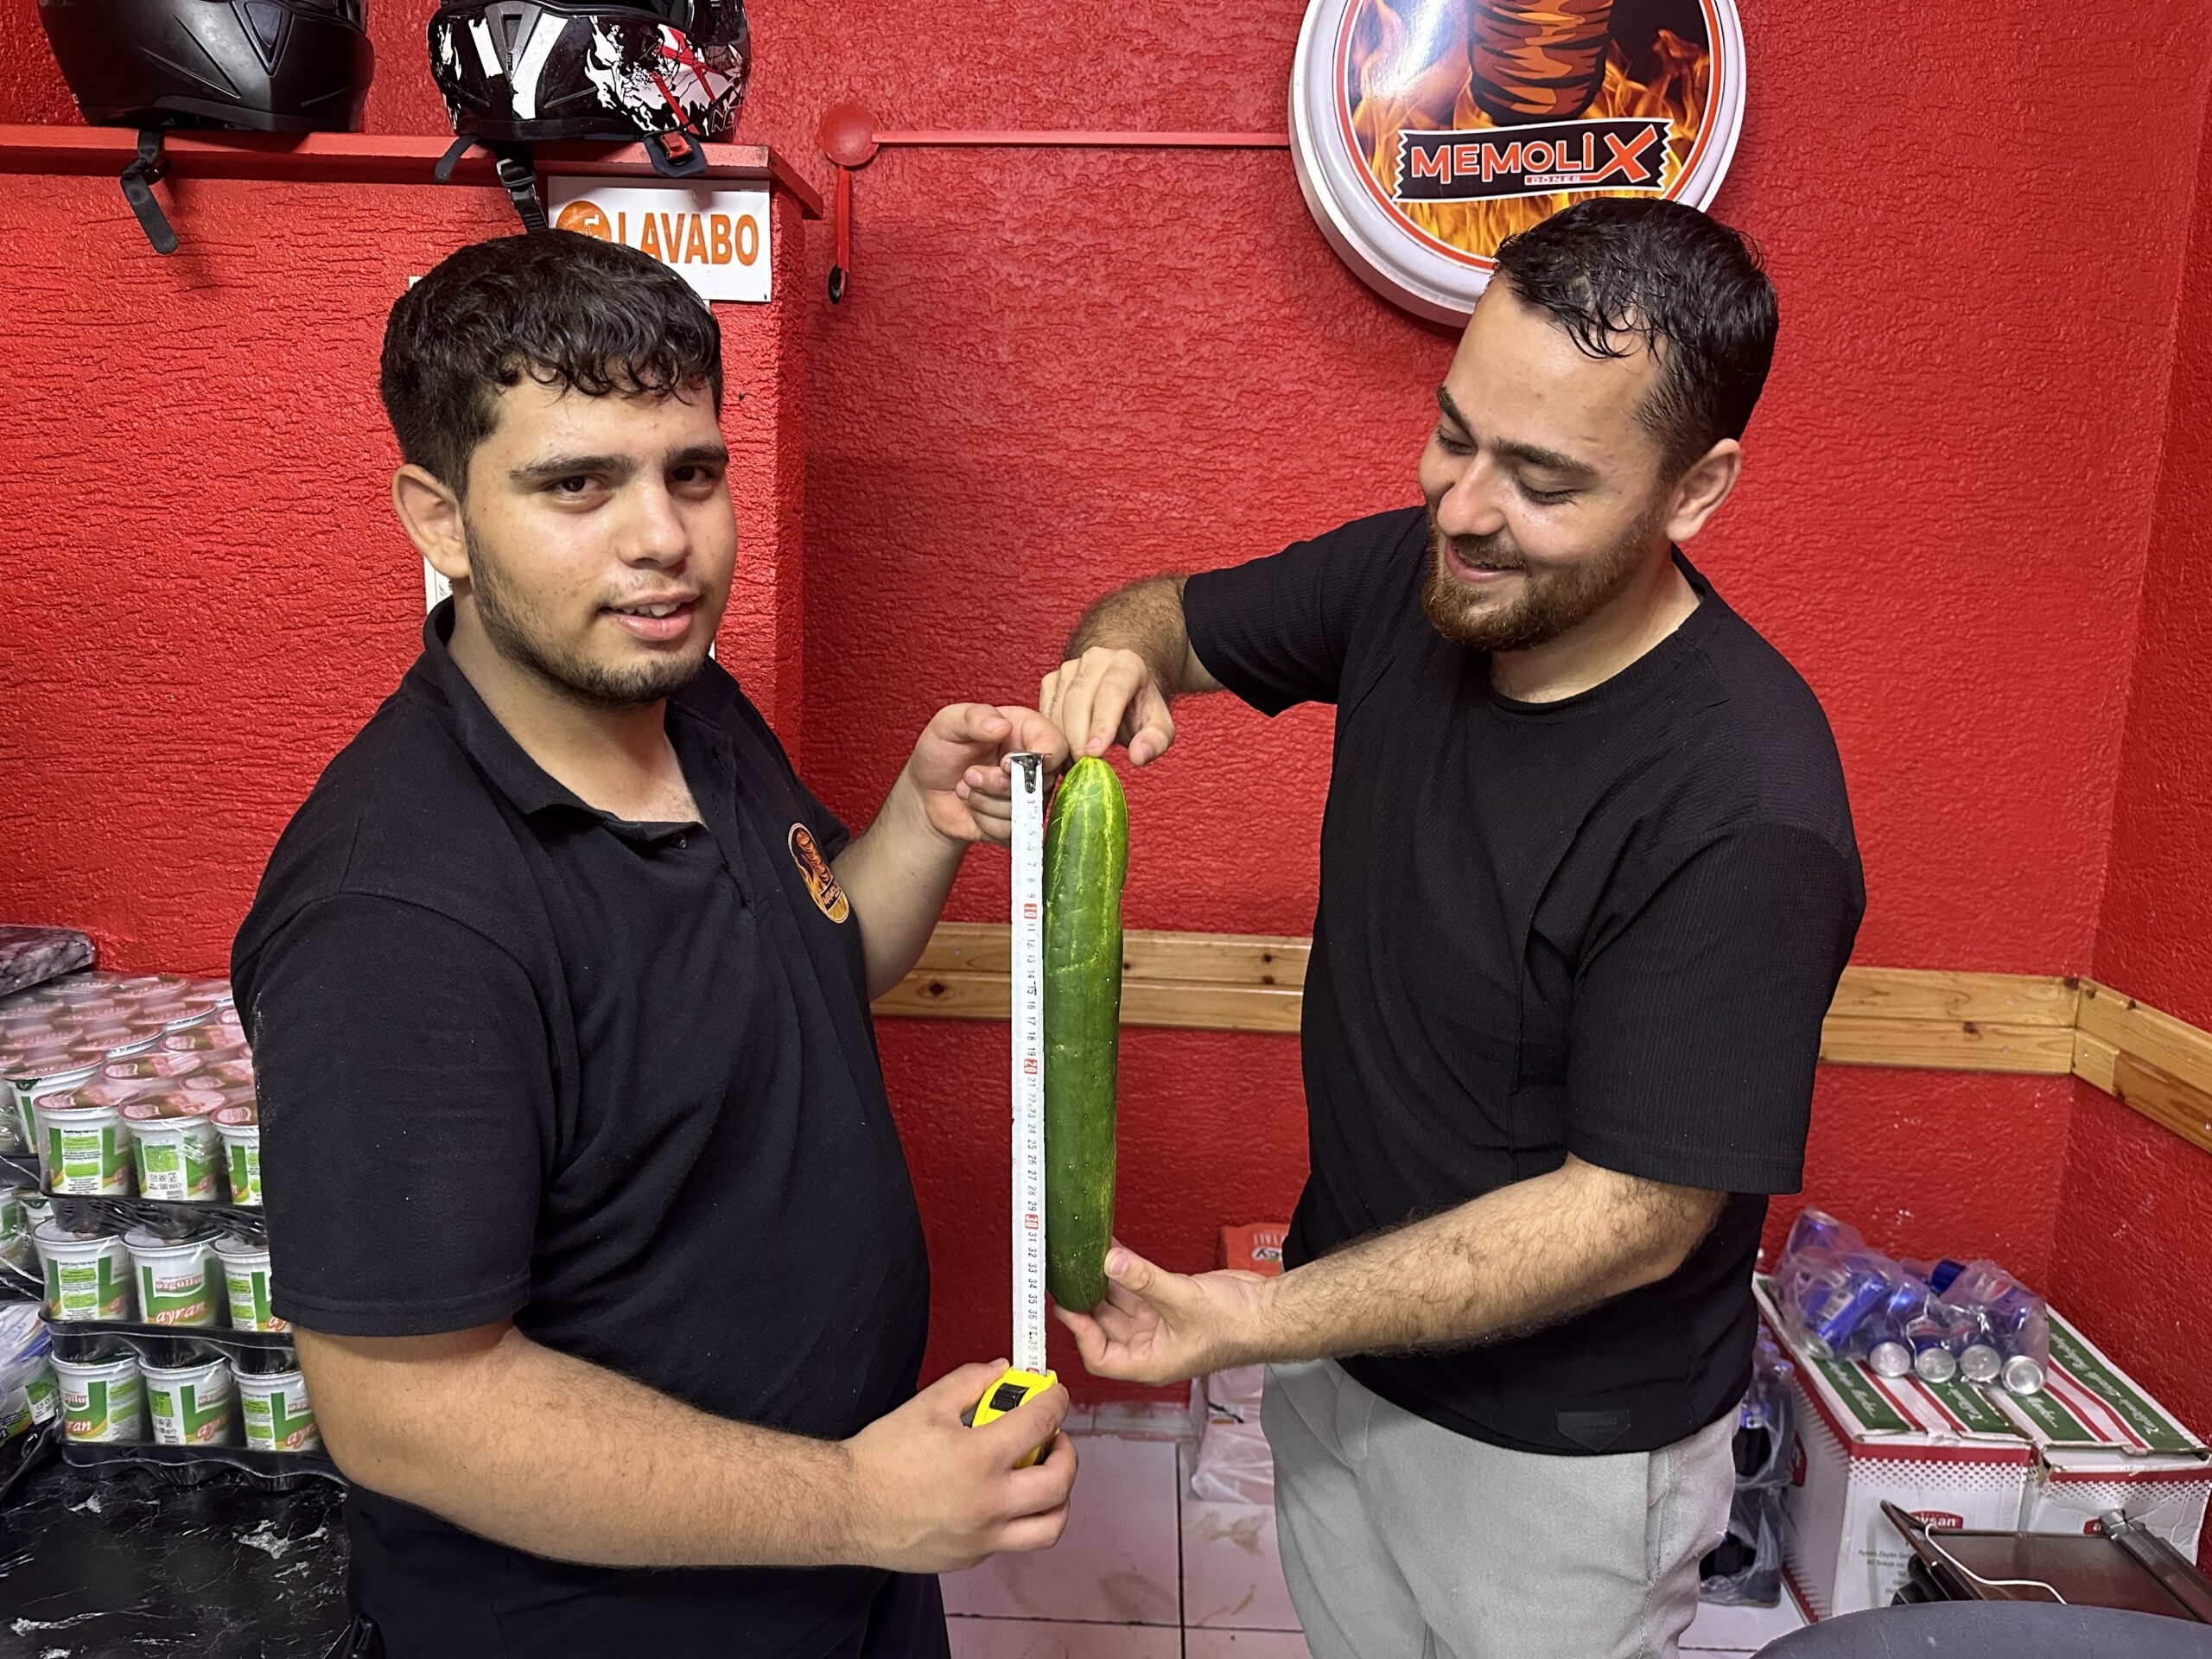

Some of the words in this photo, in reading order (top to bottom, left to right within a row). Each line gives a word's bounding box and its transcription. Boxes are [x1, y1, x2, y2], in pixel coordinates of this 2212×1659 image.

[1027, 955, 1036, 963] 13
[1027, 986, 1036, 995] 15
[1027, 1001, 1036, 1010] 16
[1027, 1016, 1036, 1026] 17
[1027, 1032, 1036, 1040] 18
[1027, 1047, 1036, 1057] 19
[1024, 1060, 1037, 1073] 20
[1027, 1077, 1036, 1087] 21
[1027, 1124, 1036, 1134] 24
[1027, 1139, 1036, 1149] 25
[1027, 1154, 1036, 1165] 26
[1027, 1170, 1036, 1180] 27
[1027, 1185, 1036, 1196] 28
[1027, 1201, 1036, 1211] 29
[1025, 1215, 1039, 1230] 30
[1028, 1232, 1037, 1242] 31
[1028, 1248, 1037, 1258] 32
[1028, 1262, 1037, 1273] 33
[1028, 1278, 1037, 1288] 34
[1028, 1294, 1037, 1304] 35
[156, 1301, 206, 1326] ayran
[1028, 1309, 1037, 1319] 36
